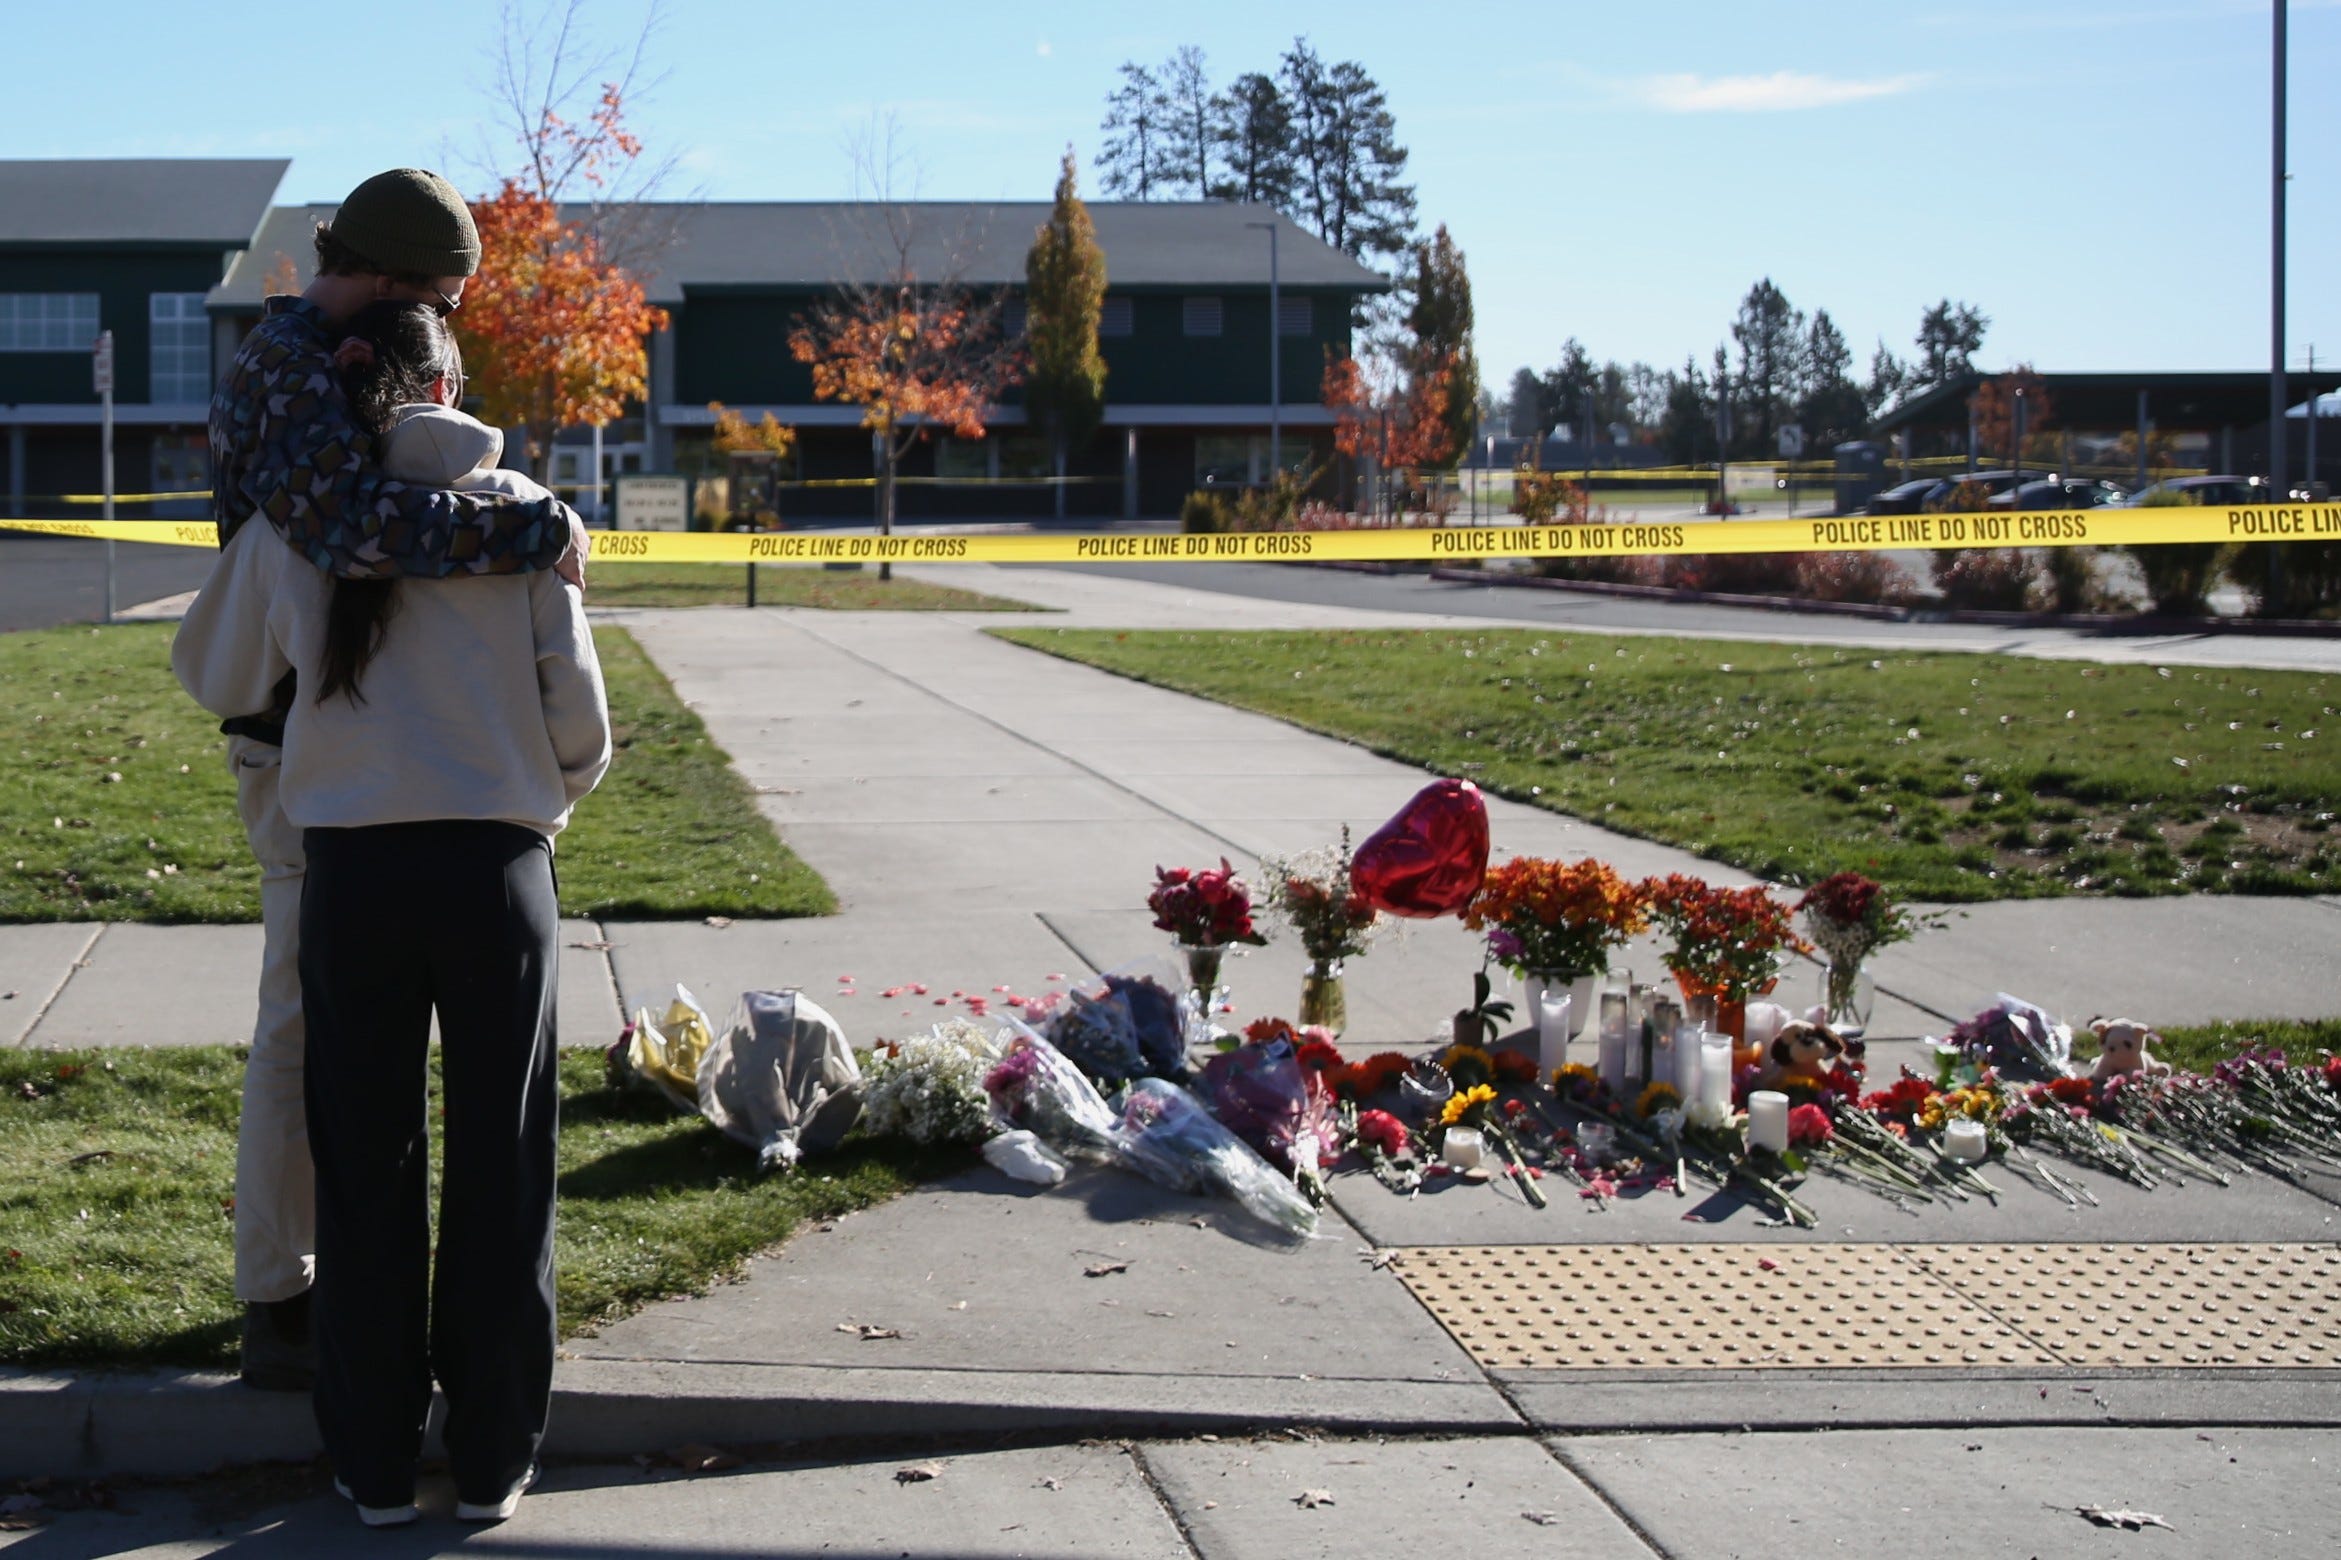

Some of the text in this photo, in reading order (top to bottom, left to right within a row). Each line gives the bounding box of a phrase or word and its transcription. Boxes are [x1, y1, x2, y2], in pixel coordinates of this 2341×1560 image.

[1812, 514, 2087, 543] POLICE LINE DO NOT CROSS
[2228, 508, 2341, 534] POLICE LIN
[175, 526, 217, 543] POLIC
[598, 535, 649, 555] CROSS
[1431, 526, 1684, 552] POLICE LINE DO NOT CROSS
[749, 538, 967, 556] POLICE LINE DO NOT CROSS
[1077, 535, 1312, 556] POLICE LINE DO NOT CROSS
